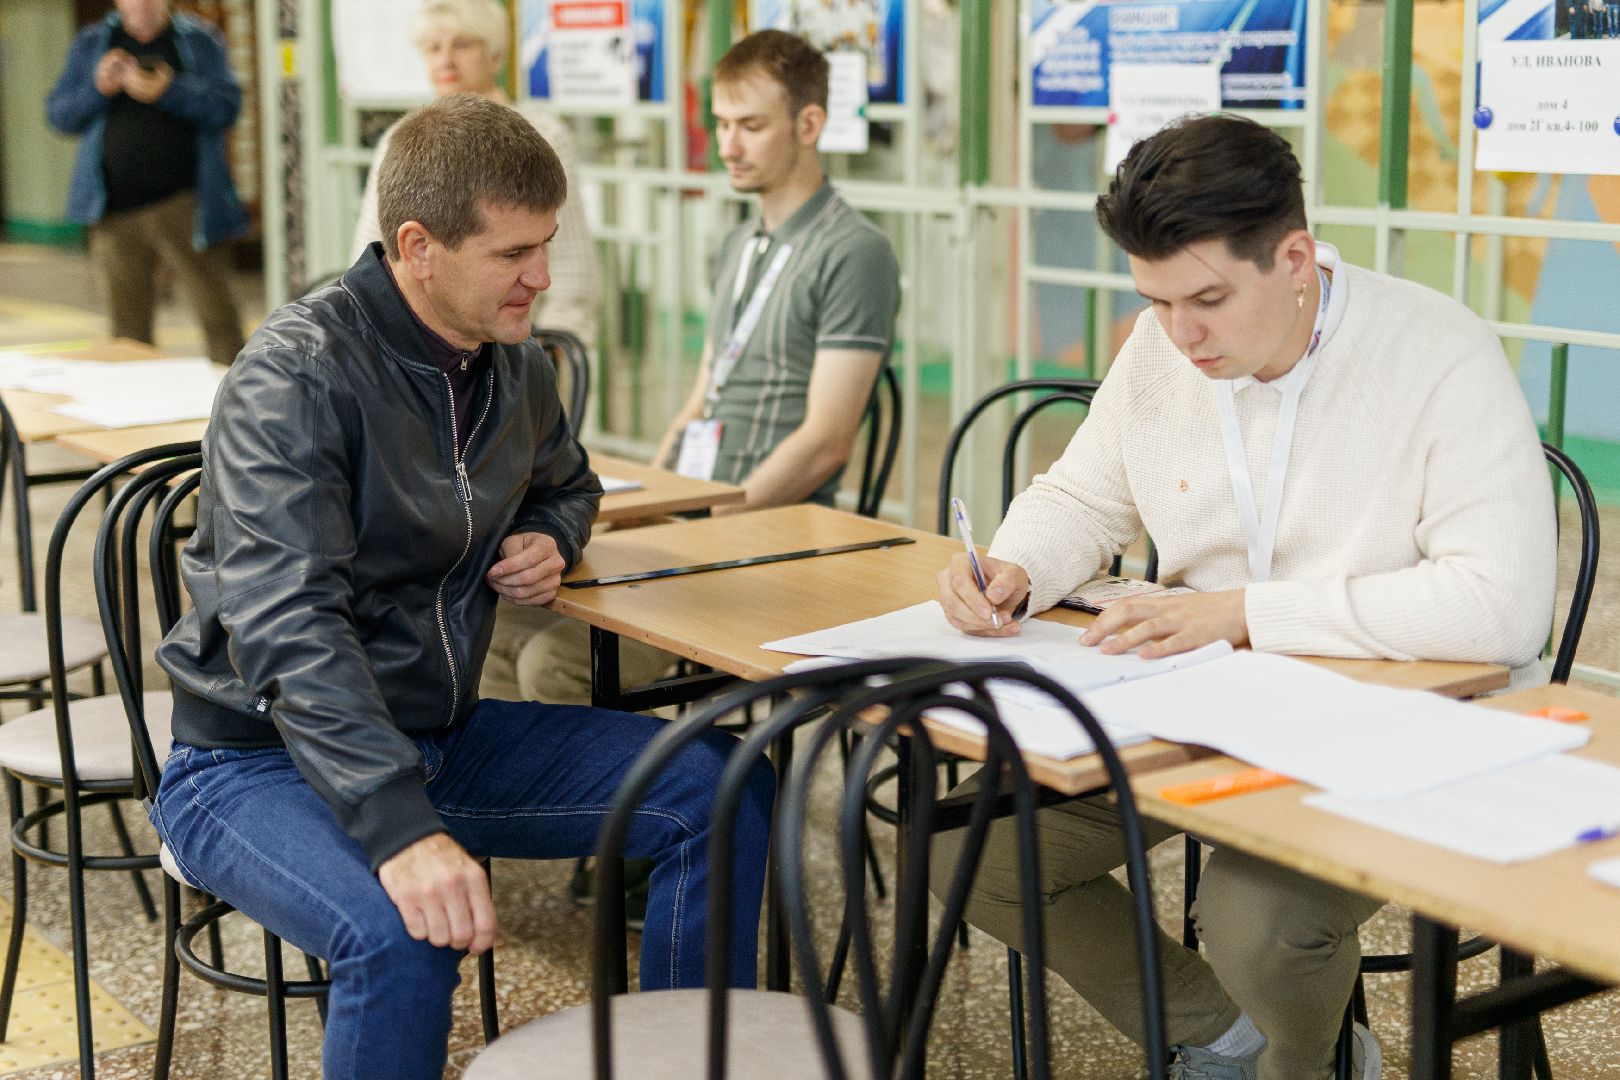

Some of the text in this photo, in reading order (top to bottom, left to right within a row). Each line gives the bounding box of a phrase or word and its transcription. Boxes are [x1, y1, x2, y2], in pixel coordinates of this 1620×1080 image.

[1536, 55, 1602, 67] ИВАНОВА
[1561, 99, 1568, 110] 4
[1579, 120, 1599, 133] 100
